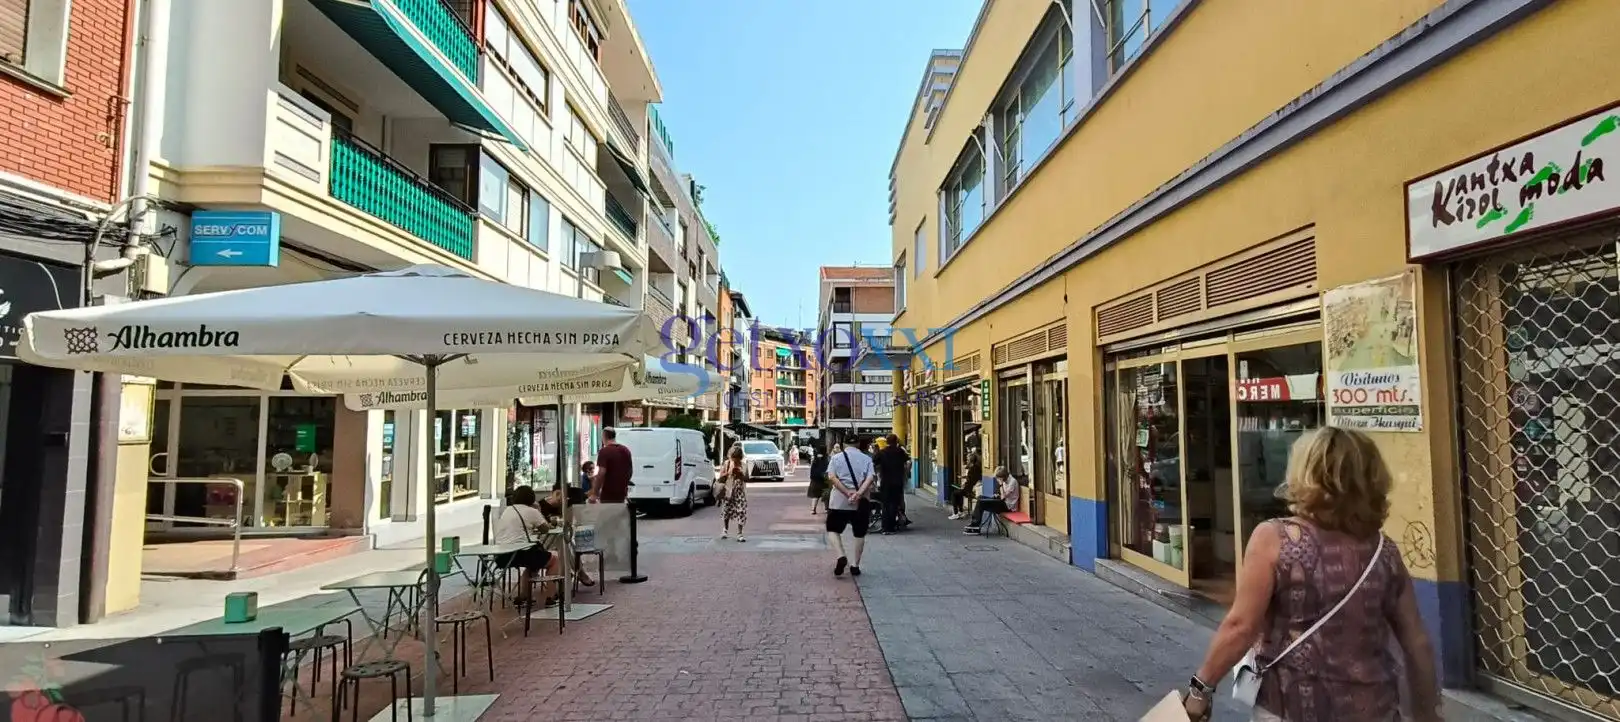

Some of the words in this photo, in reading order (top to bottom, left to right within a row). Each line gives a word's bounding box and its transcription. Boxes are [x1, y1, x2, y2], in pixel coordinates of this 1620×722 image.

[1519, 150, 1605, 208] moda
[107, 323, 240, 352] Alhambra
[443, 332, 503, 346] CERVEZA
[507, 331, 551, 345] HECHA
[555, 332, 577, 345] SIN
[583, 333, 620, 346] PRISA
[518, 382, 549, 394] CERVEZA
[551, 381, 575, 392] HECHA
[576, 380, 589, 390] SIN
[591, 379, 613, 389] PRISA
[375, 390, 428, 407] Alhambra
[1332, 387, 1368, 405] 300
